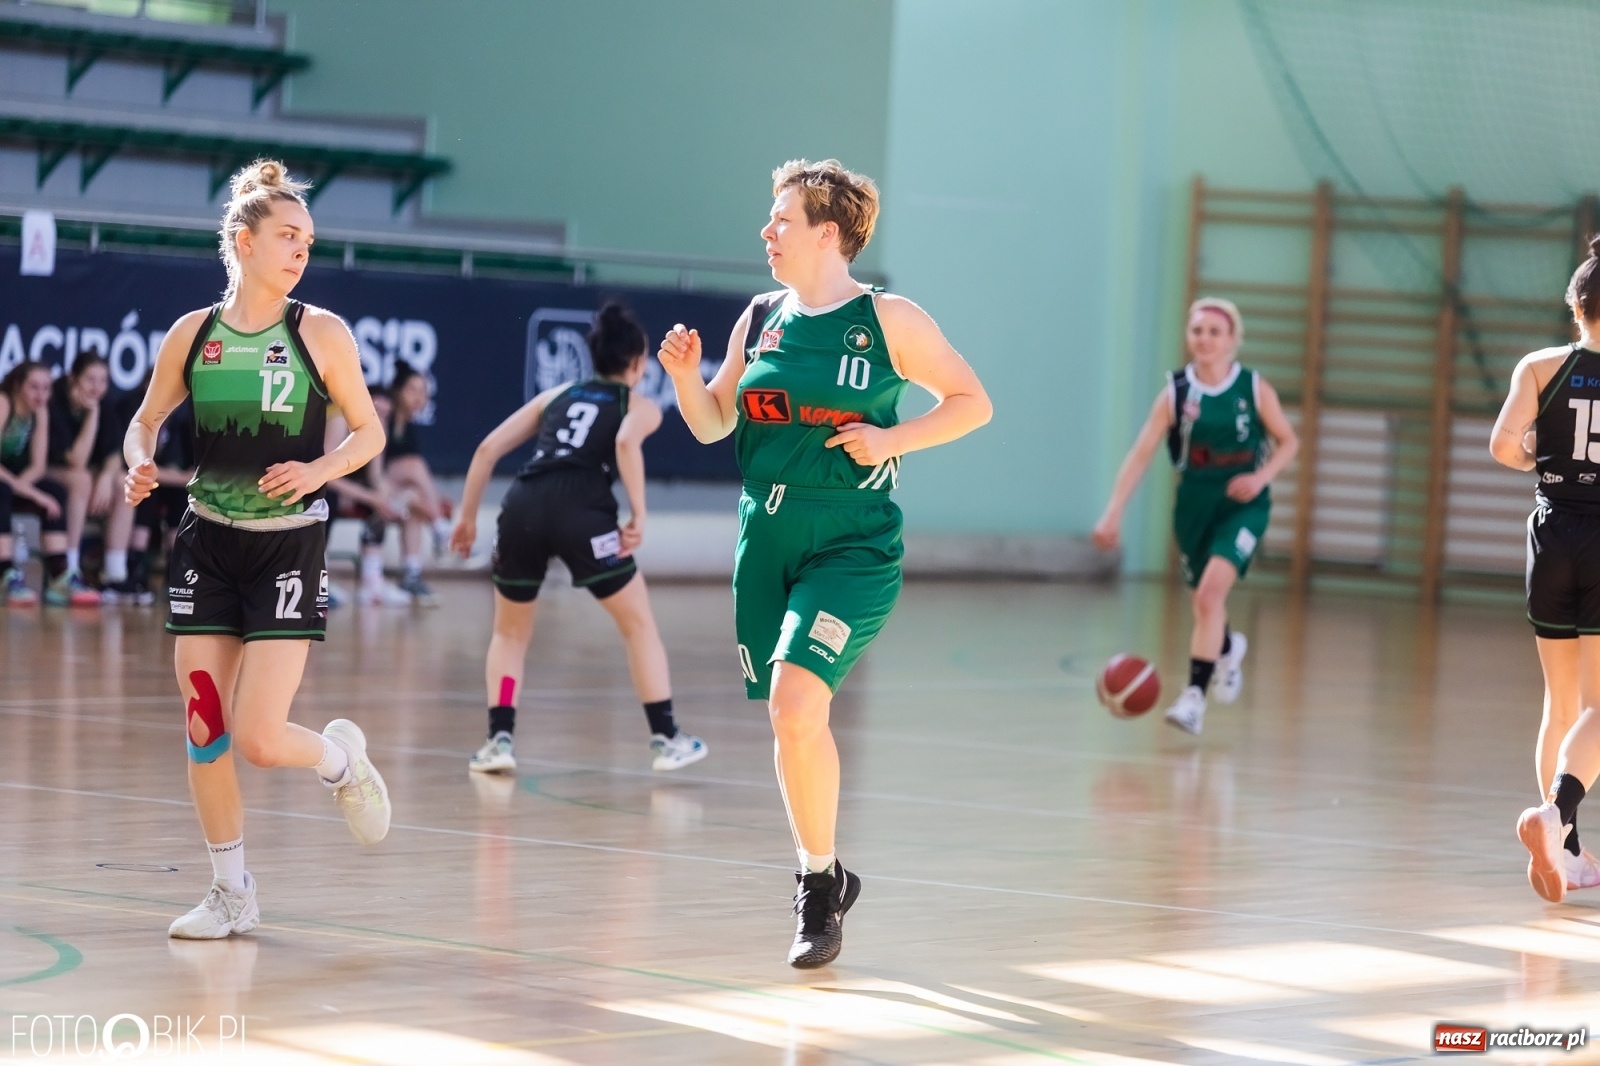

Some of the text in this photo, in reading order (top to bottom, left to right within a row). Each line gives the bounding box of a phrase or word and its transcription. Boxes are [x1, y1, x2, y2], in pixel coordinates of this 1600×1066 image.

[258, 369, 296, 413] 12
[836, 354, 871, 390] 10
[556, 402, 599, 448] 3
[744, 393, 787, 419] K
[275, 577, 303, 619] 12
